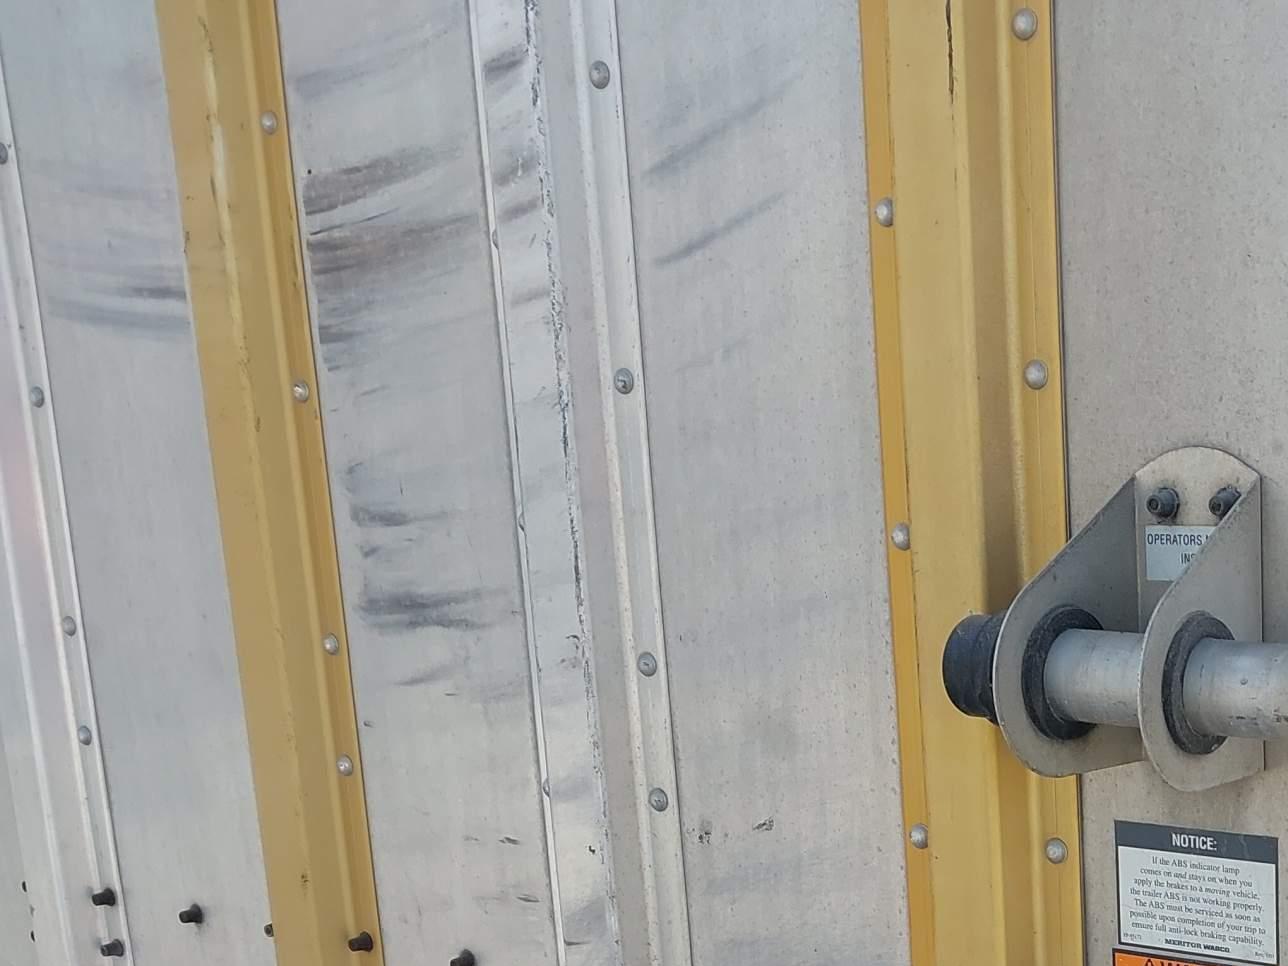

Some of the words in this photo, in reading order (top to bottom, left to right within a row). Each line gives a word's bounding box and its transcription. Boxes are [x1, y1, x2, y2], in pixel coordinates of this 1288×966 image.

[1147, 533, 1203, 546] OPERATORS
[1171, 831, 1217, 851] NOTICE:
[1160, 857, 1170, 866] the
[1171, 859, 1188, 868] ABS
[1189, 862, 1221, 873] indicator
[1222, 865, 1240, 876] lamp
[1131, 922, 1153, 930] ensure
[1155, 924, 1167, 932] full
[1168, 926, 1199, 937] anti-lock
[1200, 929, 1227, 941] braking
[1228, 934, 1264, 946] capability.
[1164, 938, 1202, 949] MERITOR
[1204, 944, 1230, 953] WABCO
